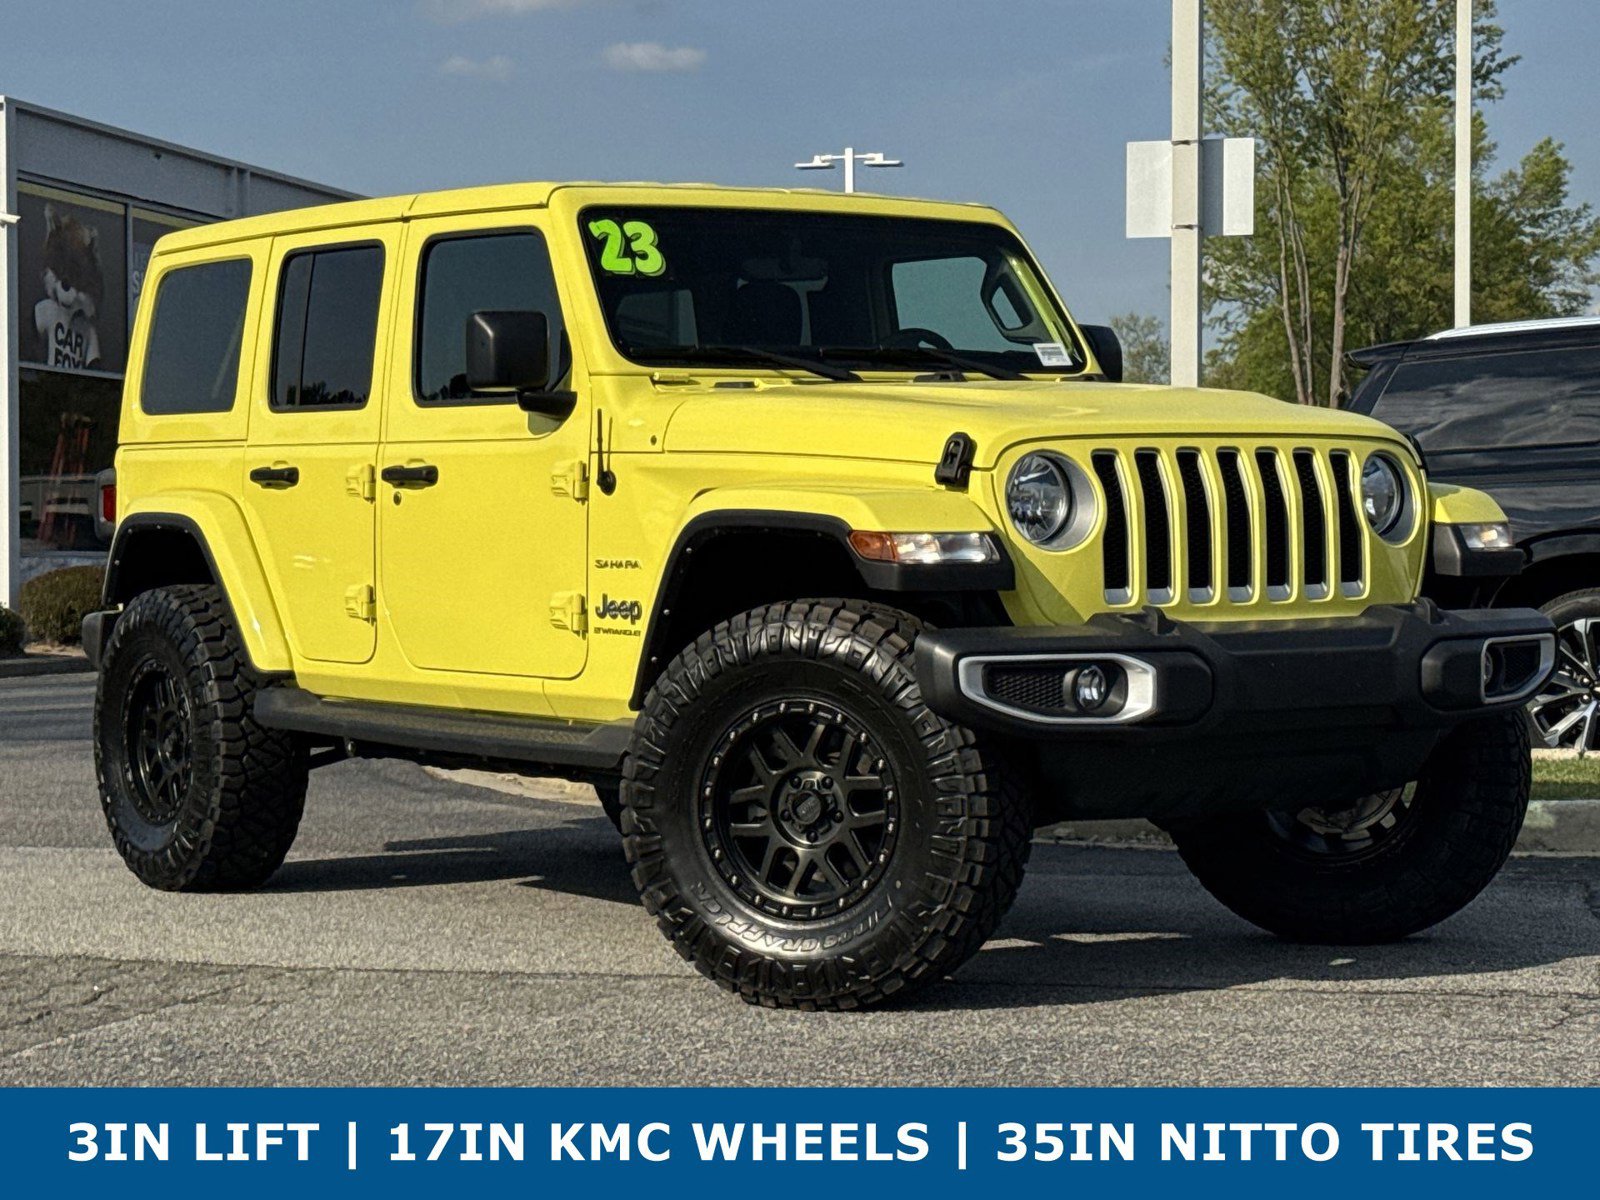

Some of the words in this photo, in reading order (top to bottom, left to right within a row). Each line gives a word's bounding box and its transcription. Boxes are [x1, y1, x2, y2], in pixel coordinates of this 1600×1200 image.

[588, 219, 666, 277] 23
[55, 321, 84, 358] CAR
[594, 559, 640, 569] SAHARA
[595, 593, 642, 625] Jeep
